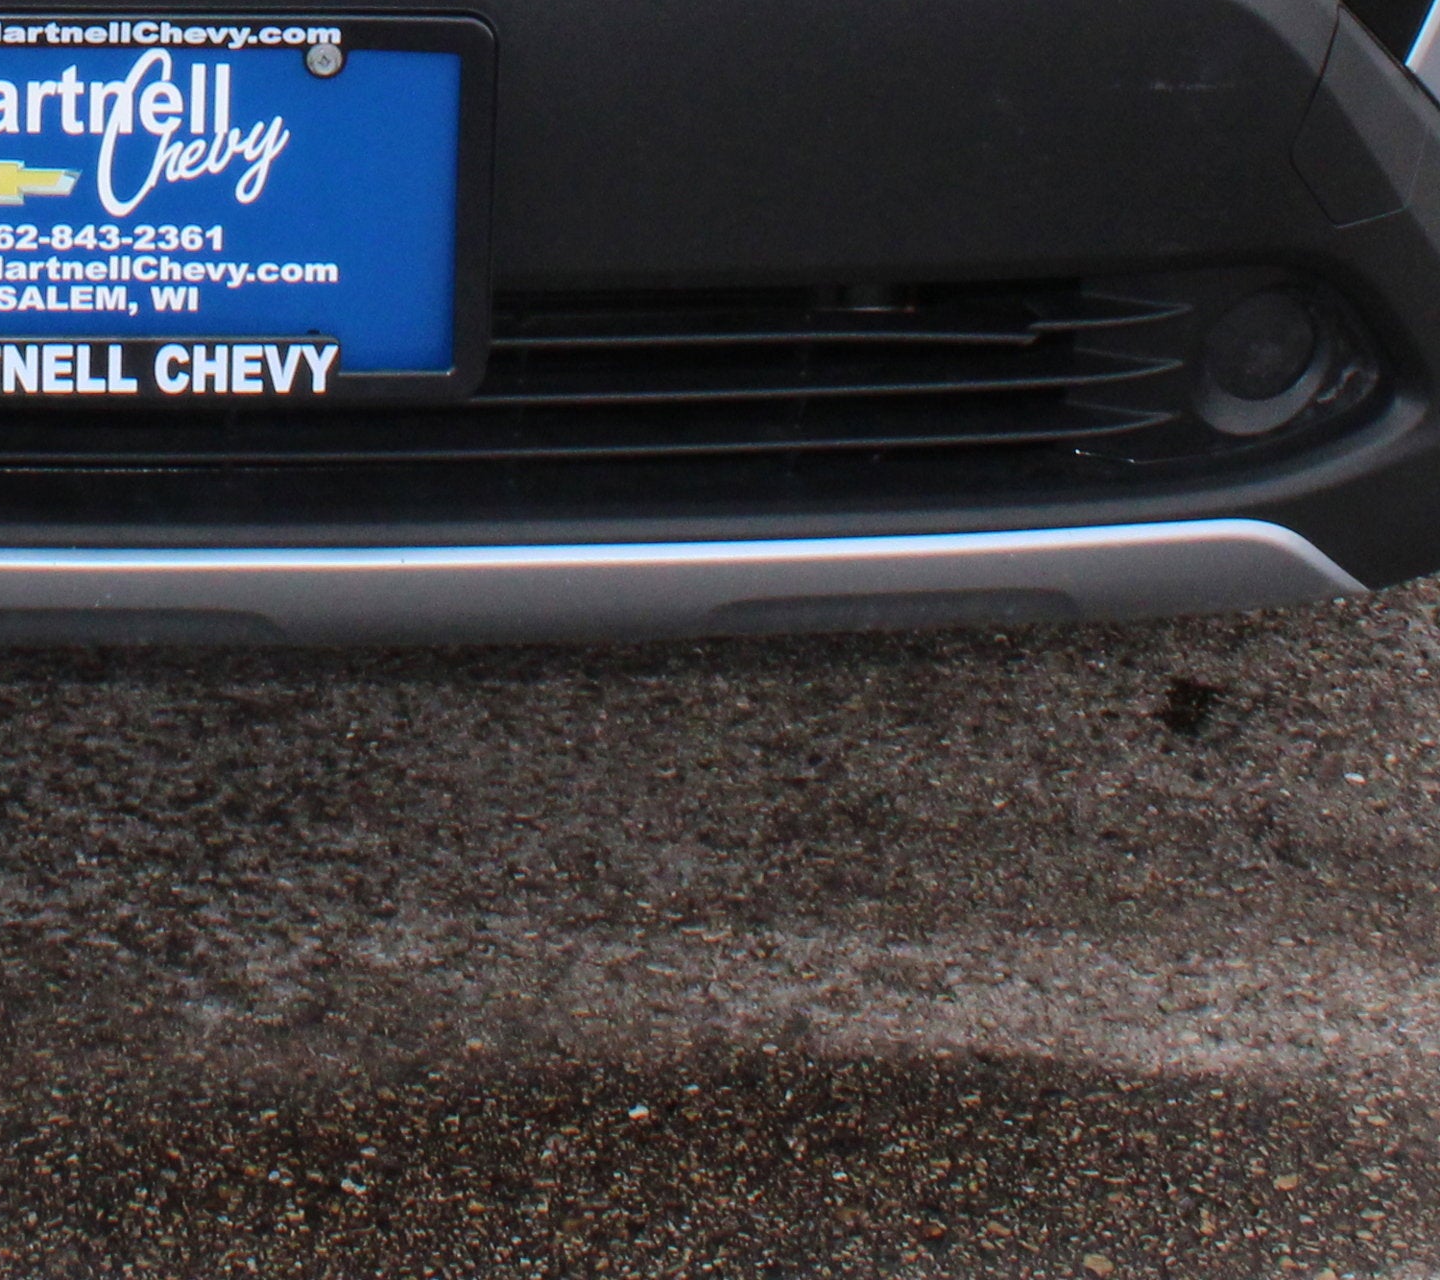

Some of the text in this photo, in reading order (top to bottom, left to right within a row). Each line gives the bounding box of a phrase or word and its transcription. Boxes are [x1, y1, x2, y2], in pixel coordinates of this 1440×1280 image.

[96, 47, 290, 218] Chevy
[150, 286, 199, 312] WI
[154, 344, 339, 394] CHEVY
